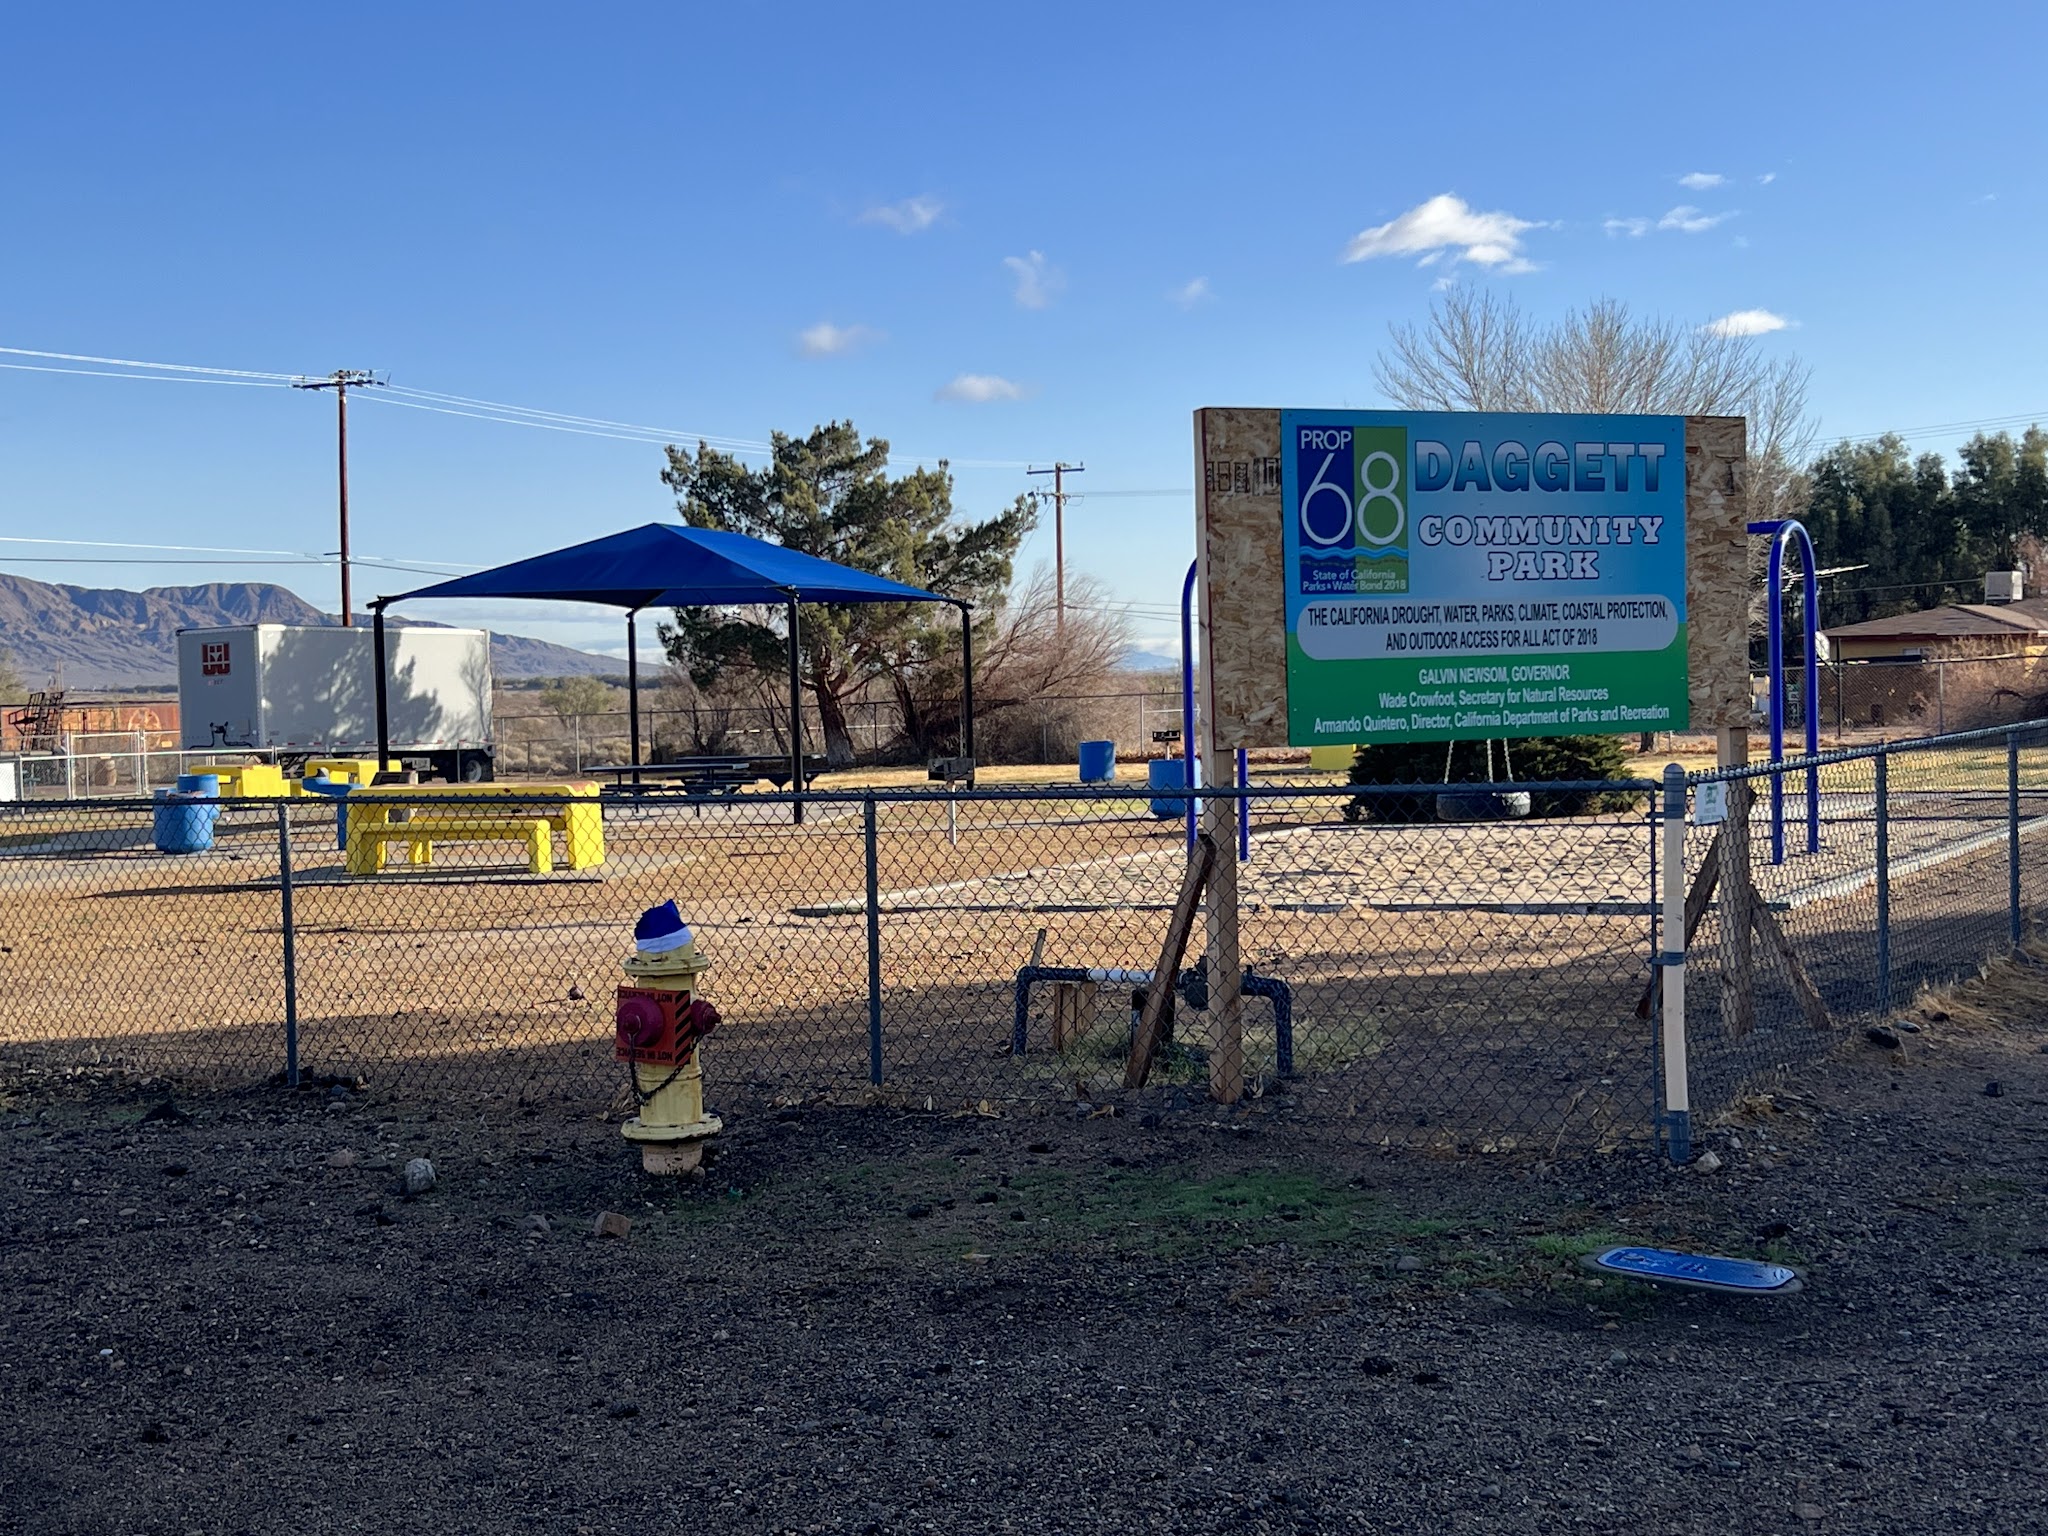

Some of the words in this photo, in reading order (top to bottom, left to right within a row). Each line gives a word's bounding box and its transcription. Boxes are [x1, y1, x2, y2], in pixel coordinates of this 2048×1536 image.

[1300, 429, 1352, 450] PROP
[1415, 440, 1666, 492] DAGGETT
[1301, 451, 1405, 546] 68
[1418, 515, 1664, 546] COMMUNITY
[1312, 569, 1338, 581] State
[1339, 568, 1351, 581] of
[1351, 568, 1396, 581] California
[1487, 550, 1600, 580] PARK
[1303, 581, 1326, 591] Parks
[1333, 580, 1359, 591] Water
[1360, 579, 1384, 591] Bond
[1384, 579, 1407, 590] 2018
[1308, 608, 1328, 626] THE
[1330, 606, 1390, 626] CALIFORNIA
[1392, 605, 1442, 627] DROUGHT,
[1443, 604, 1480, 625] WATER,
[1482, 603, 1517, 624] PARKS,
[1518, 603, 1561, 623] CLIMATE,
[1562, 602, 1605, 621] COASTAL
[1607, 601, 1668, 621] PROTECTION,
[1386, 632, 1407, 651] AND
[1409, 631, 1459, 650] OUTDOOR
[1460, 630, 1499, 649] ACCESS
[1501, 629, 1521, 648] FOR
[1522, 629, 1540, 647] ALL
[1542, 628, 1561, 647] ACT
[1562, 628, 1576, 646] OF
[1577, 628, 1598, 646] 2018
[1419, 668, 1457, 685] GALVIN
[1459, 666, 1510, 684] NEWSOM,
[1511, 664, 1570, 682] GOVERNOR
[1379, 692, 1407, 708] Wade
[1409, 690, 1457, 708] Crowfoot,
[1458, 688, 1505, 708] Secretary
[1507, 688, 1522, 703] for
[1523, 686, 1557, 703] Natural
[1558, 686, 1609, 702] Resources
[1314, 715, 1361, 734] Armando
[1363, 714, 1410, 732] Quintero,
[1411, 713, 1453, 730] Director,
[1454, 711, 1501, 728] California
[1503, 709, 1559, 729] Department
[1560, 708, 1571, 723] of
[1571, 706, 1599, 723] Parks
[1600, 706, 1619, 722] and
[1620, 704, 1670, 721] Recreation
[658, 1051, 673, 1061] NOT
